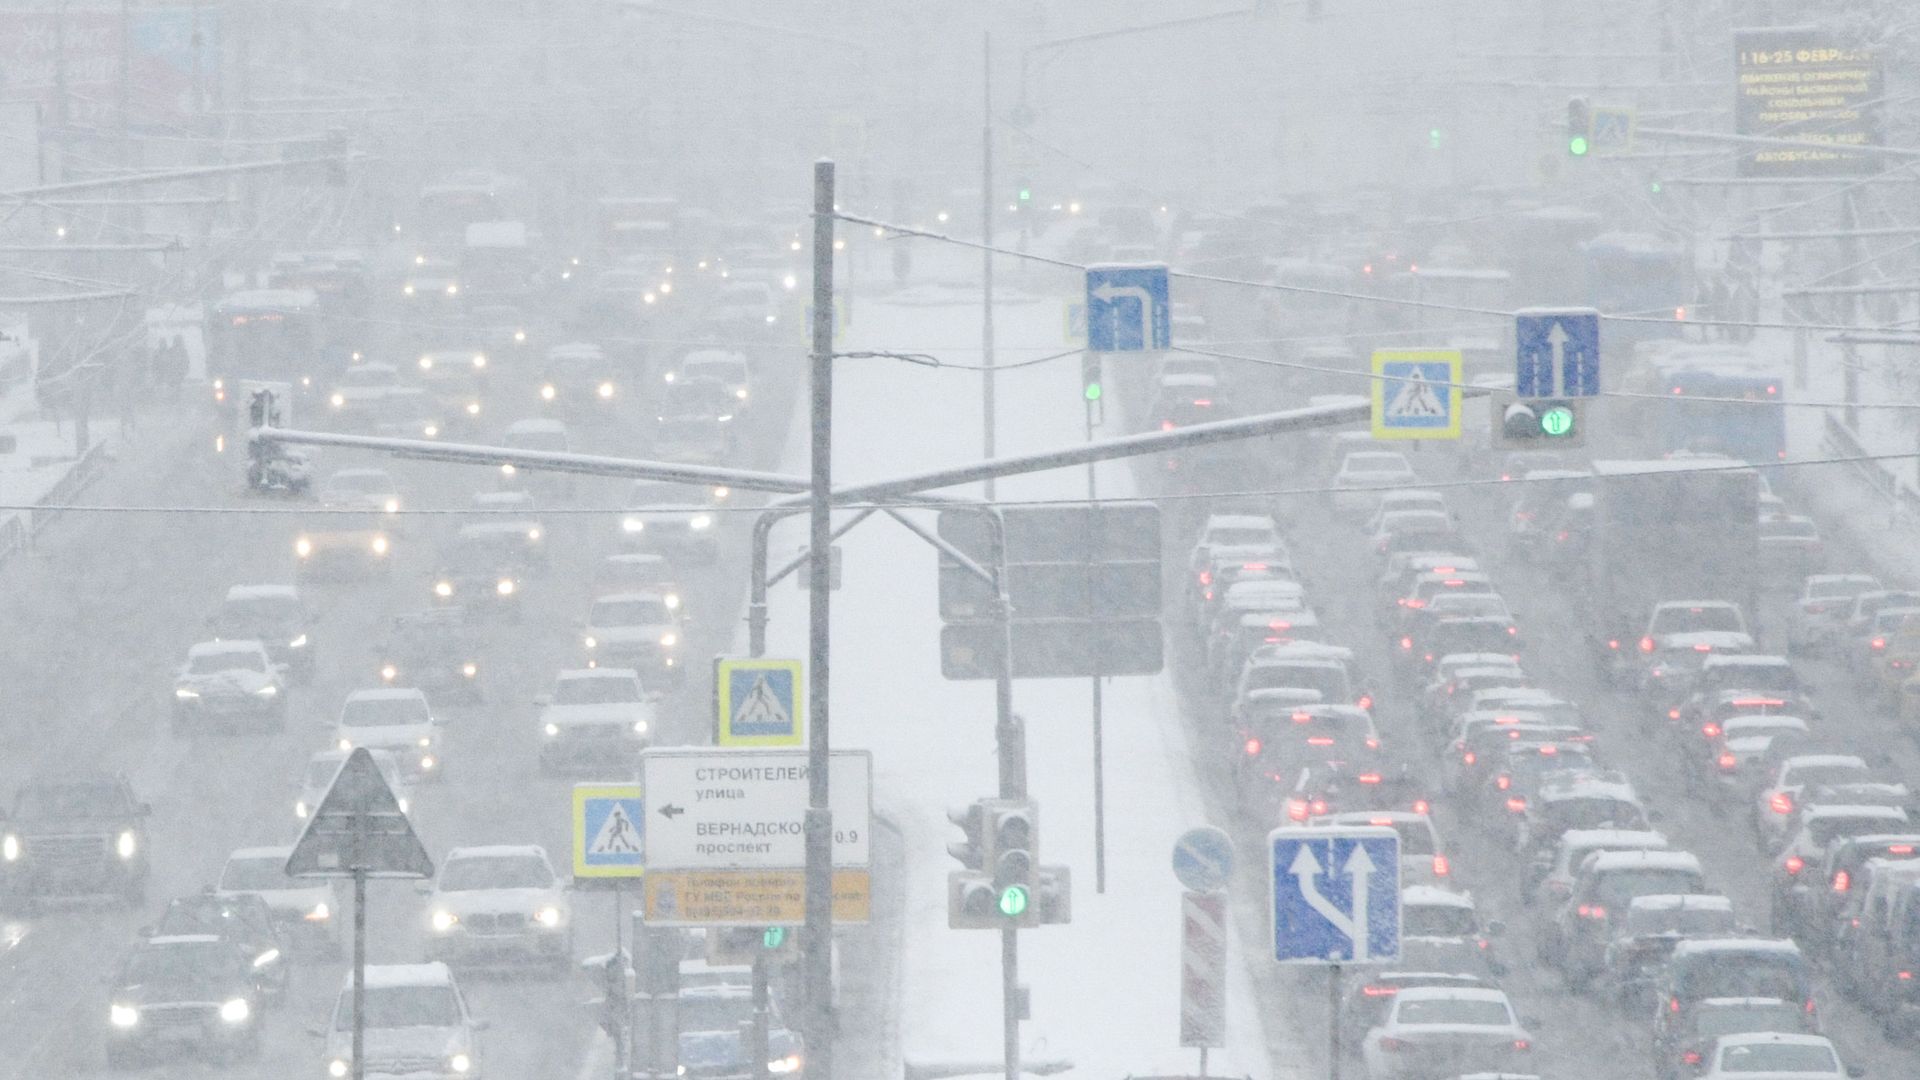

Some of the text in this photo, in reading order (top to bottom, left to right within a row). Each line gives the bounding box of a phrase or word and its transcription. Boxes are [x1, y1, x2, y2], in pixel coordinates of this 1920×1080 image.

[1752, 50, 1793, 64] 16-25
[696, 765, 811, 781] СТРОИТЕЛЕЙ
[696, 789, 745, 801] улица
[697, 822, 806, 836] ВЕРНАДСКО
[835, 831, 858, 844] 0.9
[696, 843, 771, 854] проспект
